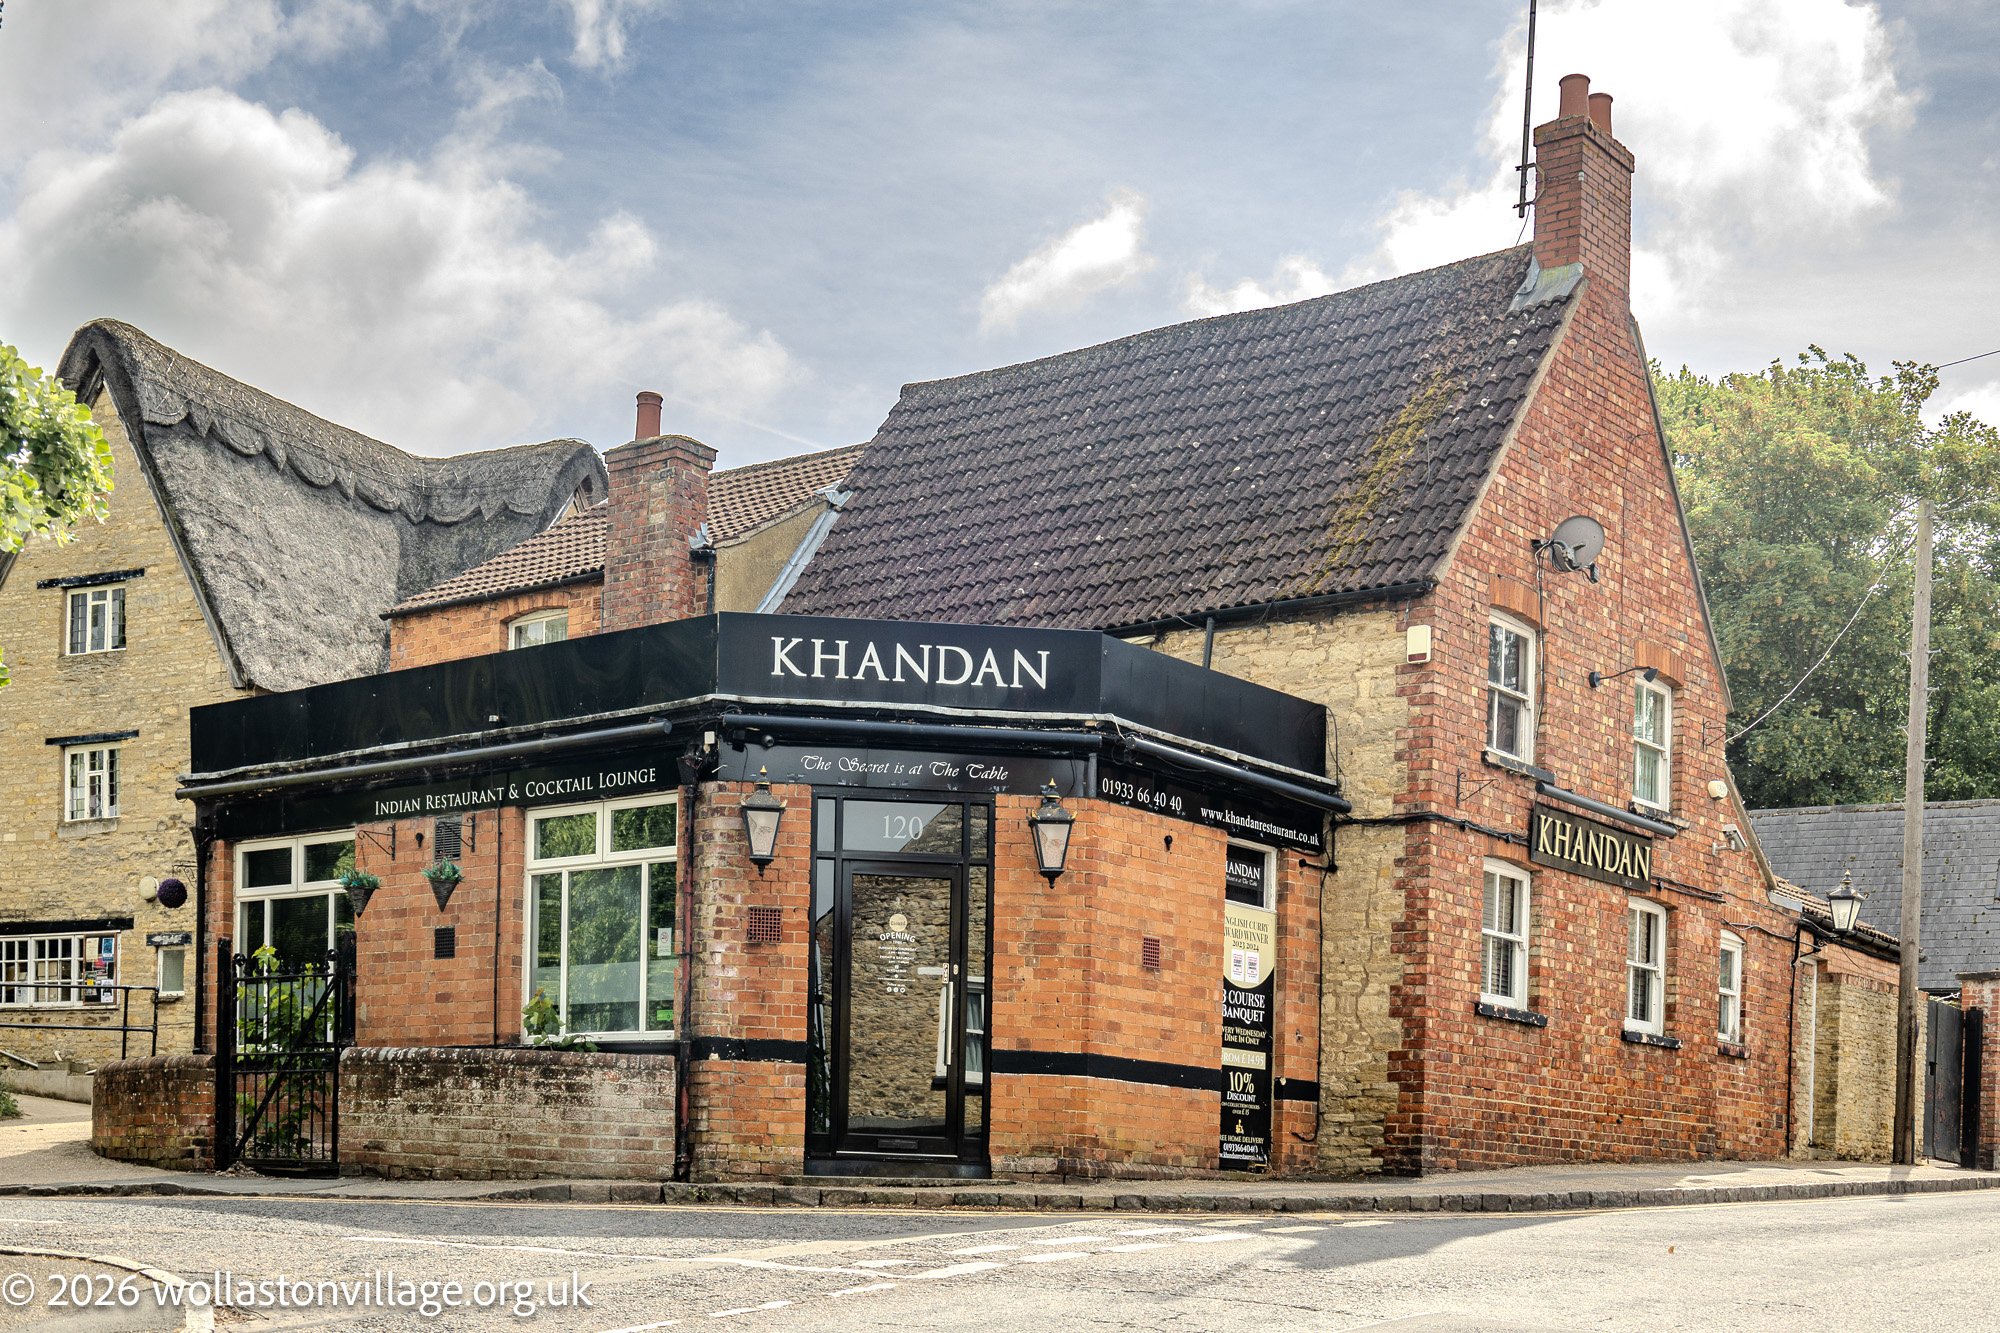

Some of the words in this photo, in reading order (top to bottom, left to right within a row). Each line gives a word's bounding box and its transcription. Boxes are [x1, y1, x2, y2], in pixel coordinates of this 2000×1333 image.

[771, 636, 1050, 690] KHANDAN
[801, 755, 832, 771] The
[838, 756, 890, 774] Secret
[894, 762, 903, 774] is
[908, 764, 923, 775] at
[929, 761, 960, 777] The
[965, 763, 1009, 781] Table
[375, 798, 421, 816] INDIAN
[426, 787, 505, 811] RESTAURANT
[508, 783, 519, 799] &
[526, 776, 594, 798] COCKTAIL
[600, 768, 656, 788] LOUNGE
[1102, 777, 1134, 800] 01933
[1137, 787, 1150, 804] 66
[1153, 791, 1167, 808] 40
[1169, 795, 1182, 811] 40
[882, 814, 923, 840] 120
[1200, 807, 1320, 846] www.khandanrestaurant.co.uk
[1538, 814, 1651, 882] KHANDAN
[1225, 860, 1260, 880] ANDAN
[1225, 916, 1248, 929] NGLISH
[1249, 920, 1269, 933] CURRY
[880, 932, 916, 943] OPENING
[1224, 926, 1243, 940] WARD
[1243, 930, 1269, 945] WINNER
[1232, 940, 1245, 949] 2023
[1246, 943, 1259, 952] 2024
[1228, 989, 1265, 1008] COURSE
[1222, 1004, 1265, 1025] BANQUET
[1222, 1026, 1234, 1034] VERY
[1235, 1026, 1266, 1038] WEDNESDAY
[1224, 1033, 1238, 1043] DINE
[1238, 1034, 1245, 1043] IN
[1245, 1036, 1260, 1046] ONLY
[1223, 1052, 1240, 1063] ROM
[1229, 1071, 1255, 1094] 10%
[1227, 1091, 1256, 1102] DISCOUNT
[1242, 1136, 1264, 1144] DELIVERY
